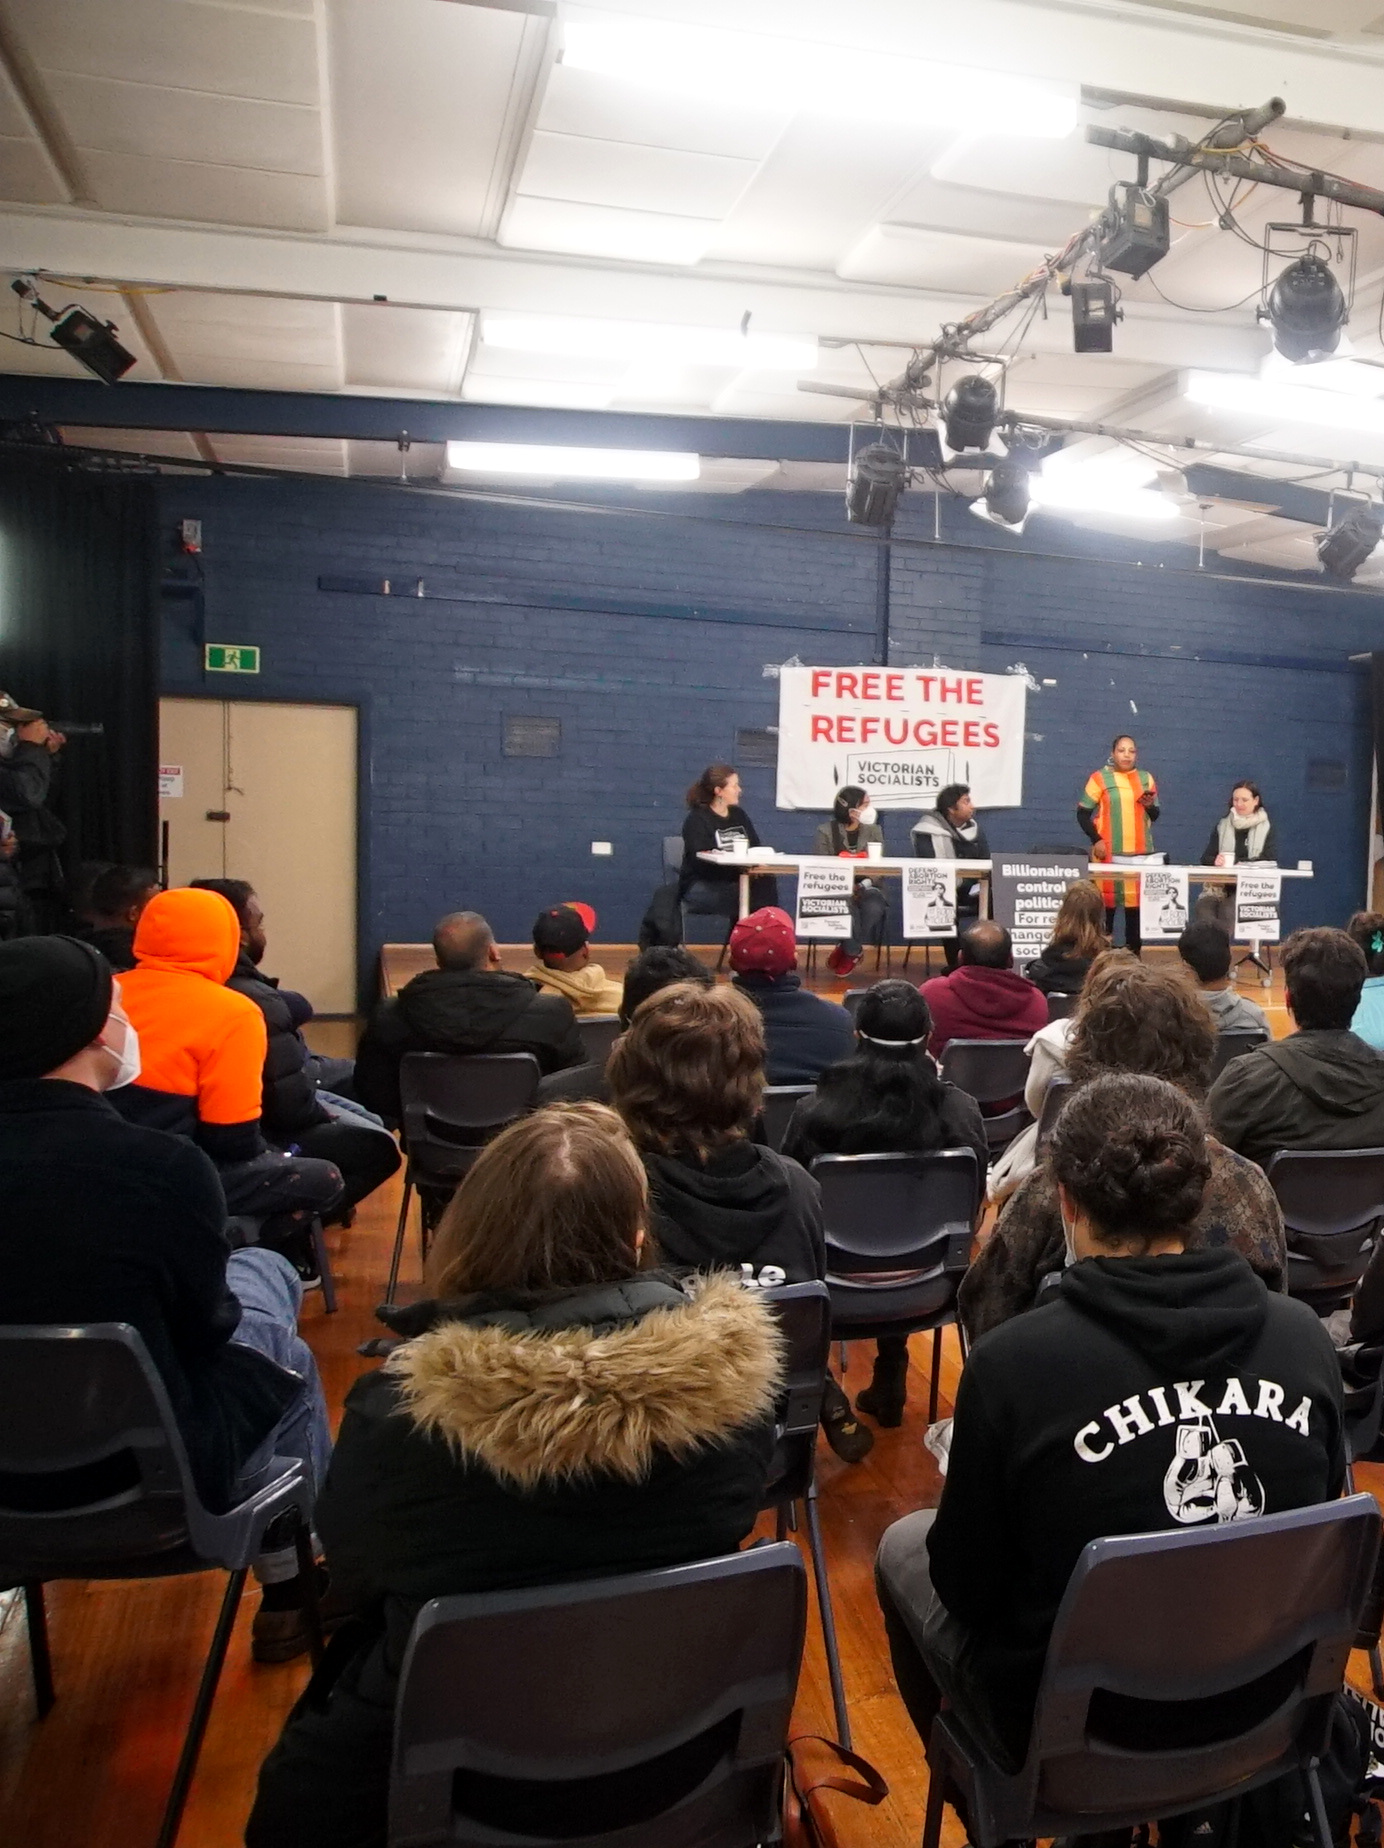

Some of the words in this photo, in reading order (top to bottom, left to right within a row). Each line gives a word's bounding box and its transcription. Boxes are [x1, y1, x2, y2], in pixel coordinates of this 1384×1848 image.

[811, 670, 904, 701] FREE
[916, 675, 984, 705] THE
[811, 715, 1000, 748] REFUGEES
[858, 760, 935, 776] VICTORIAN
[858, 773, 940, 787] SOCIALISTS
[804, 871, 826, 880] Free
[829, 873, 846, 881] the
[1002, 864, 1080, 877] Billionaires
[803, 881, 849, 892] refugees
[1016, 881, 1066, 893] control
[1240, 881, 1259, 889] Free
[1240, 890, 1277, 899] refugees
[802, 898, 847, 907] VICTORIAN
[802, 905, 849, 914] SOCIALISTS
[1018, 913, 1039, 923] For
[1074, 1378, 1312, 1463] CHIKARA
